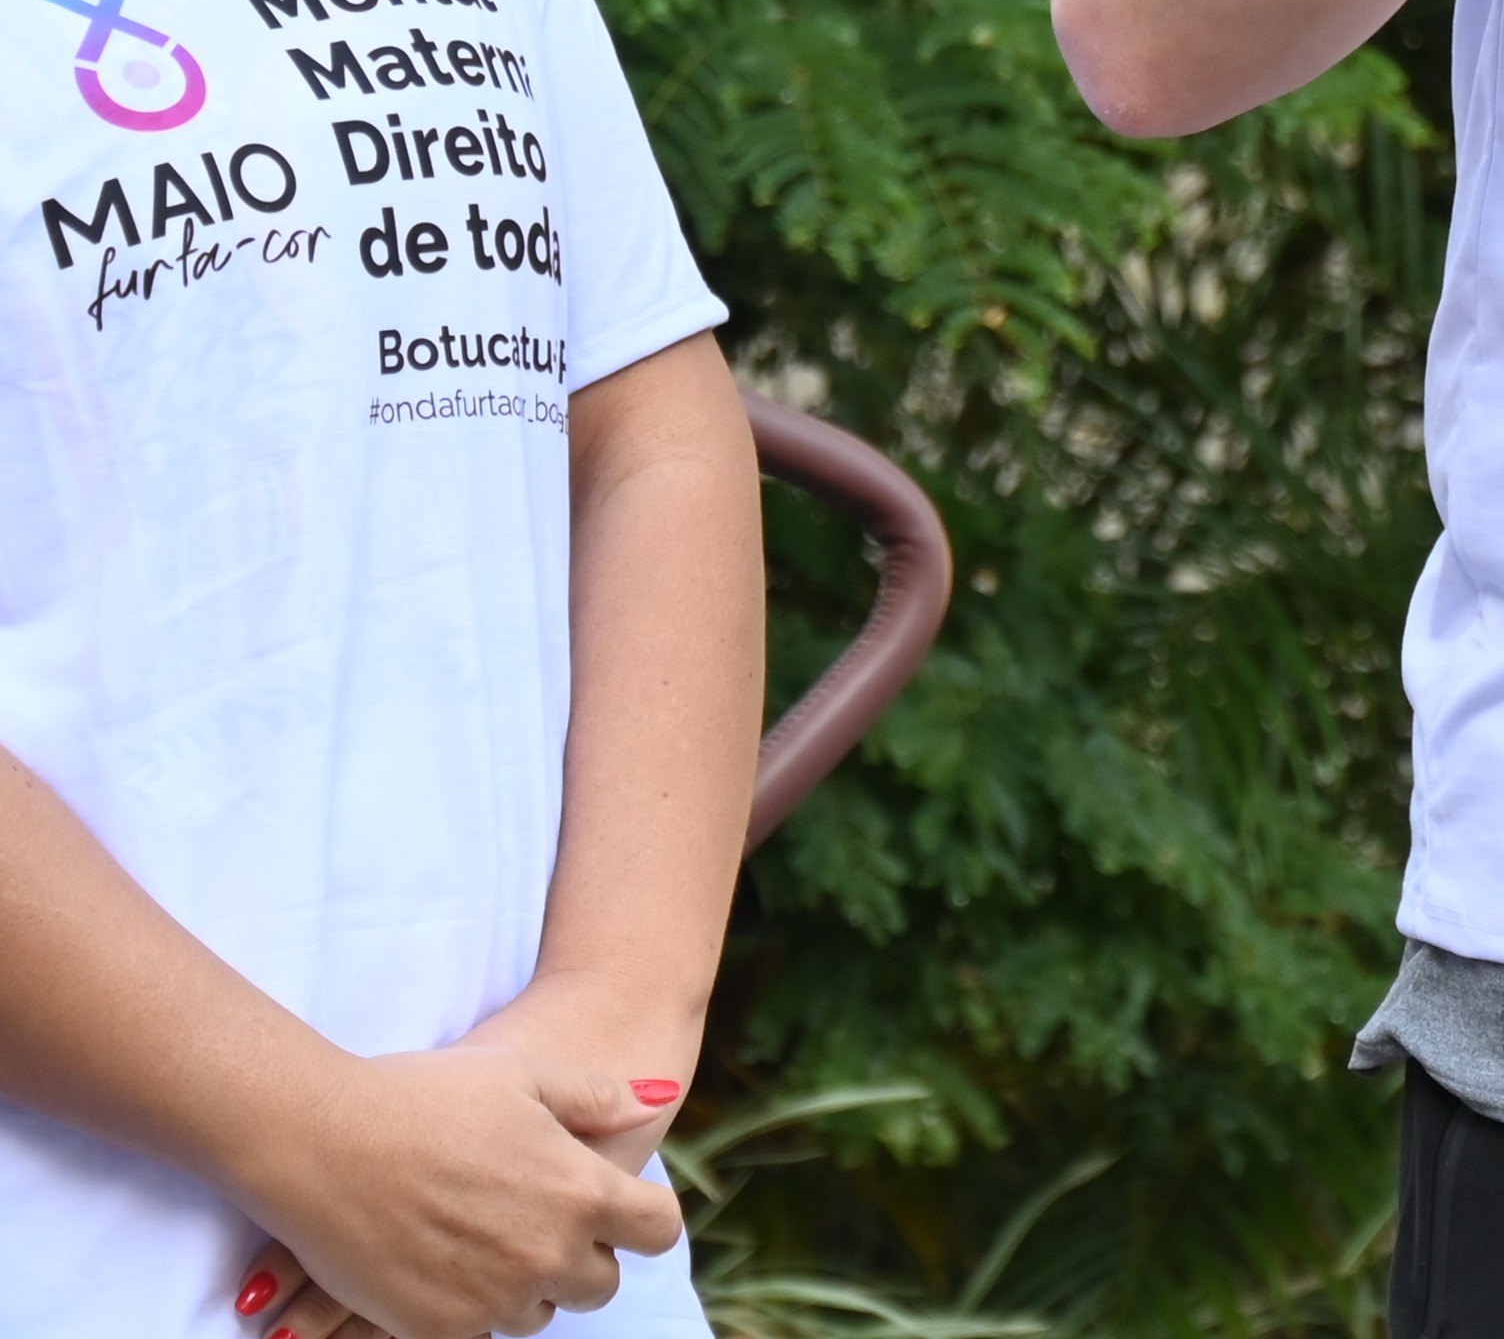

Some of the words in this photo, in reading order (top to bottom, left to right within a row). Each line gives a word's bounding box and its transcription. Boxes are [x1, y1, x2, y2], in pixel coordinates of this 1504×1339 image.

[330, 108, 548, 187] Direito
[40, 142, 298, 271] MAIO
[358, 205, 450, 280] de
[86, 216, 332, 333] furta-cor
